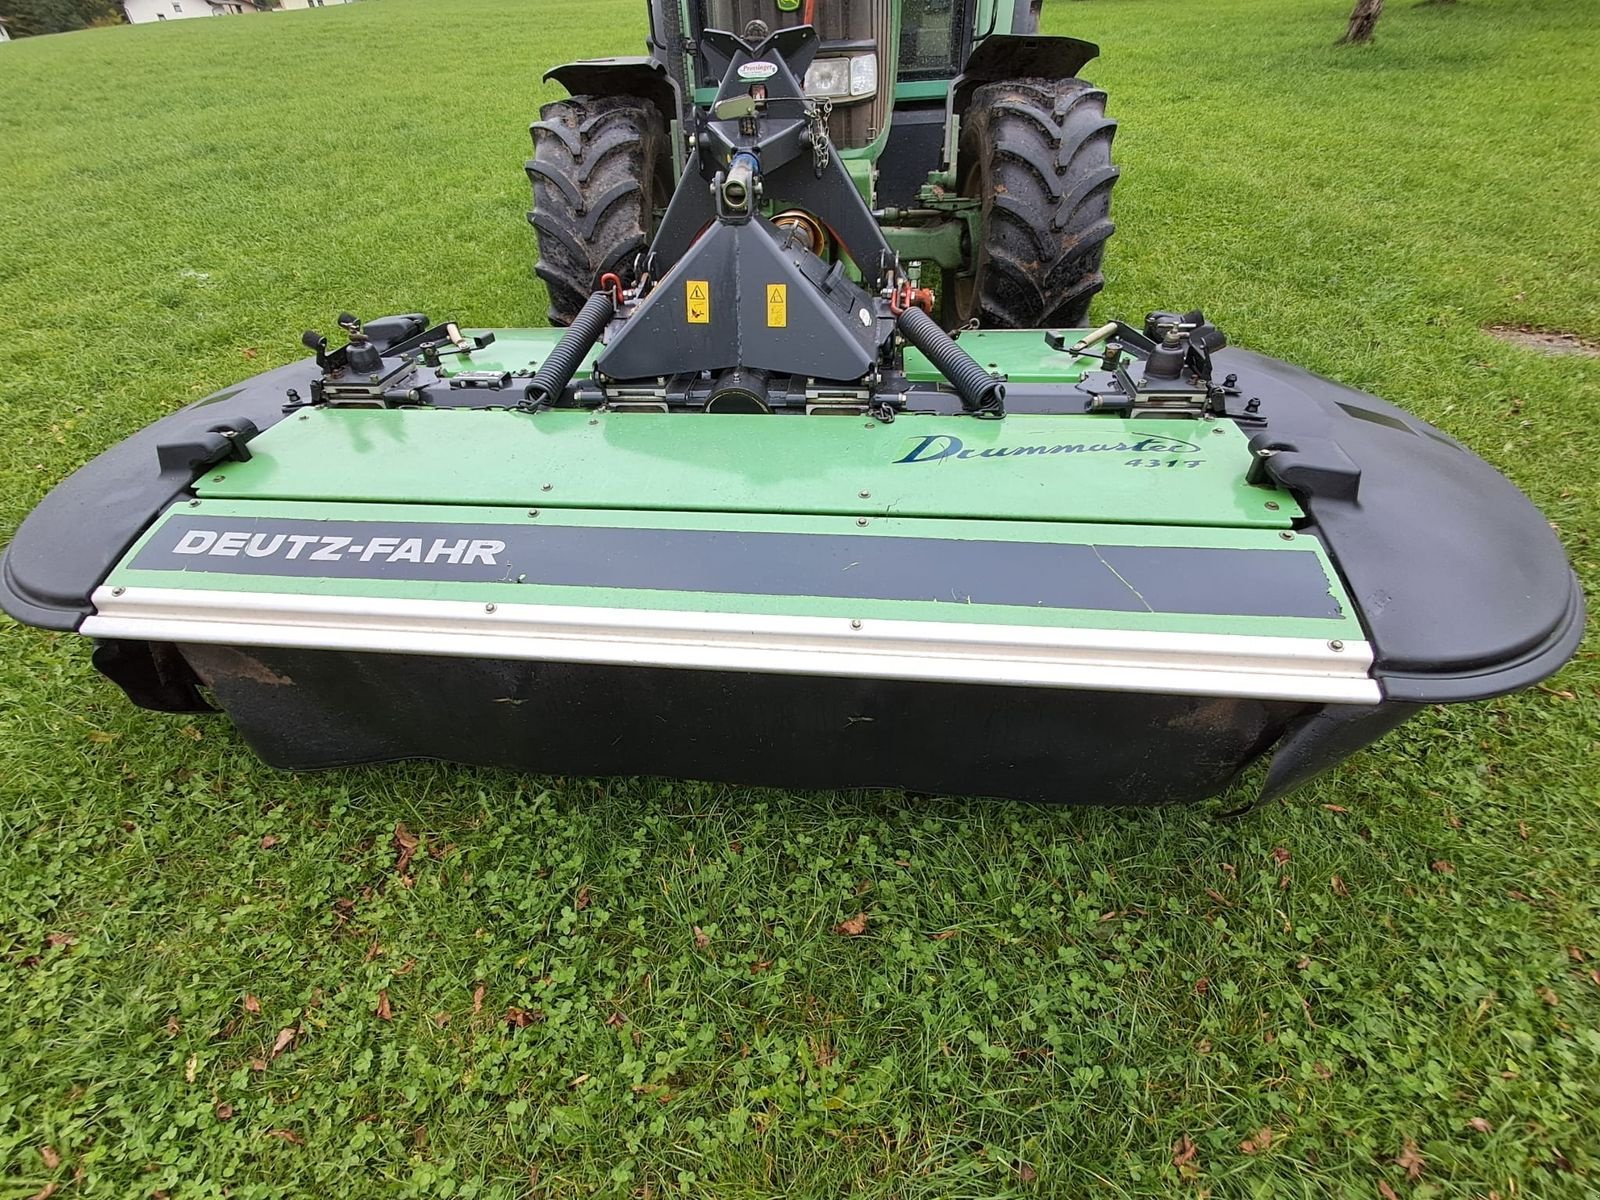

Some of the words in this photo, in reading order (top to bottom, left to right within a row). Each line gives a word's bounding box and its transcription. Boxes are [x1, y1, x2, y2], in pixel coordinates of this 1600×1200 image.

[892, 433, 1201, 464] Drummaster
[1124, 458, 1207, 469] 431T
[172, 529, 506, 566] DEUTZ-FAHR
